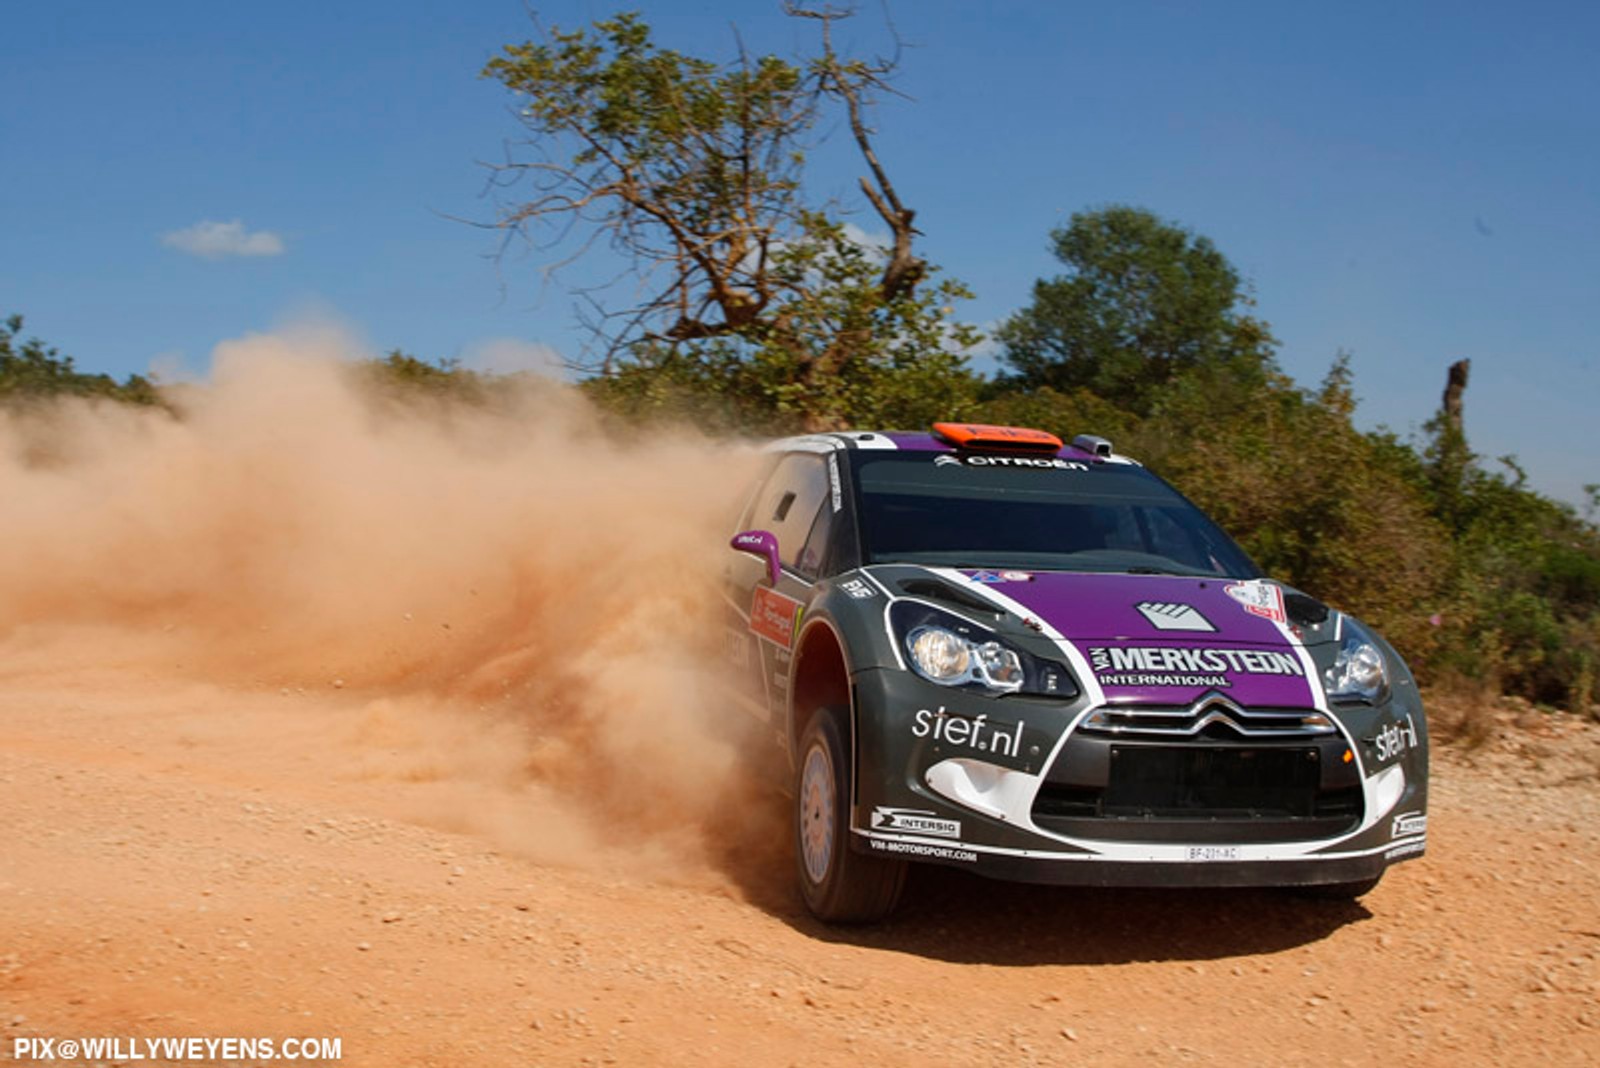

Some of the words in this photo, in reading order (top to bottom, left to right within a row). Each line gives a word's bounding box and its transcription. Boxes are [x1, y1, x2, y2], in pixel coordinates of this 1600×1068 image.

[1100, 674, 1231, 687] INTERNATIONAL
[911, 706, 1024, 757] stef.nl
[900, 818, 956, 832] INTERSIG
[870, 840, 978, 862] VM-MOTORSPORT.COM
